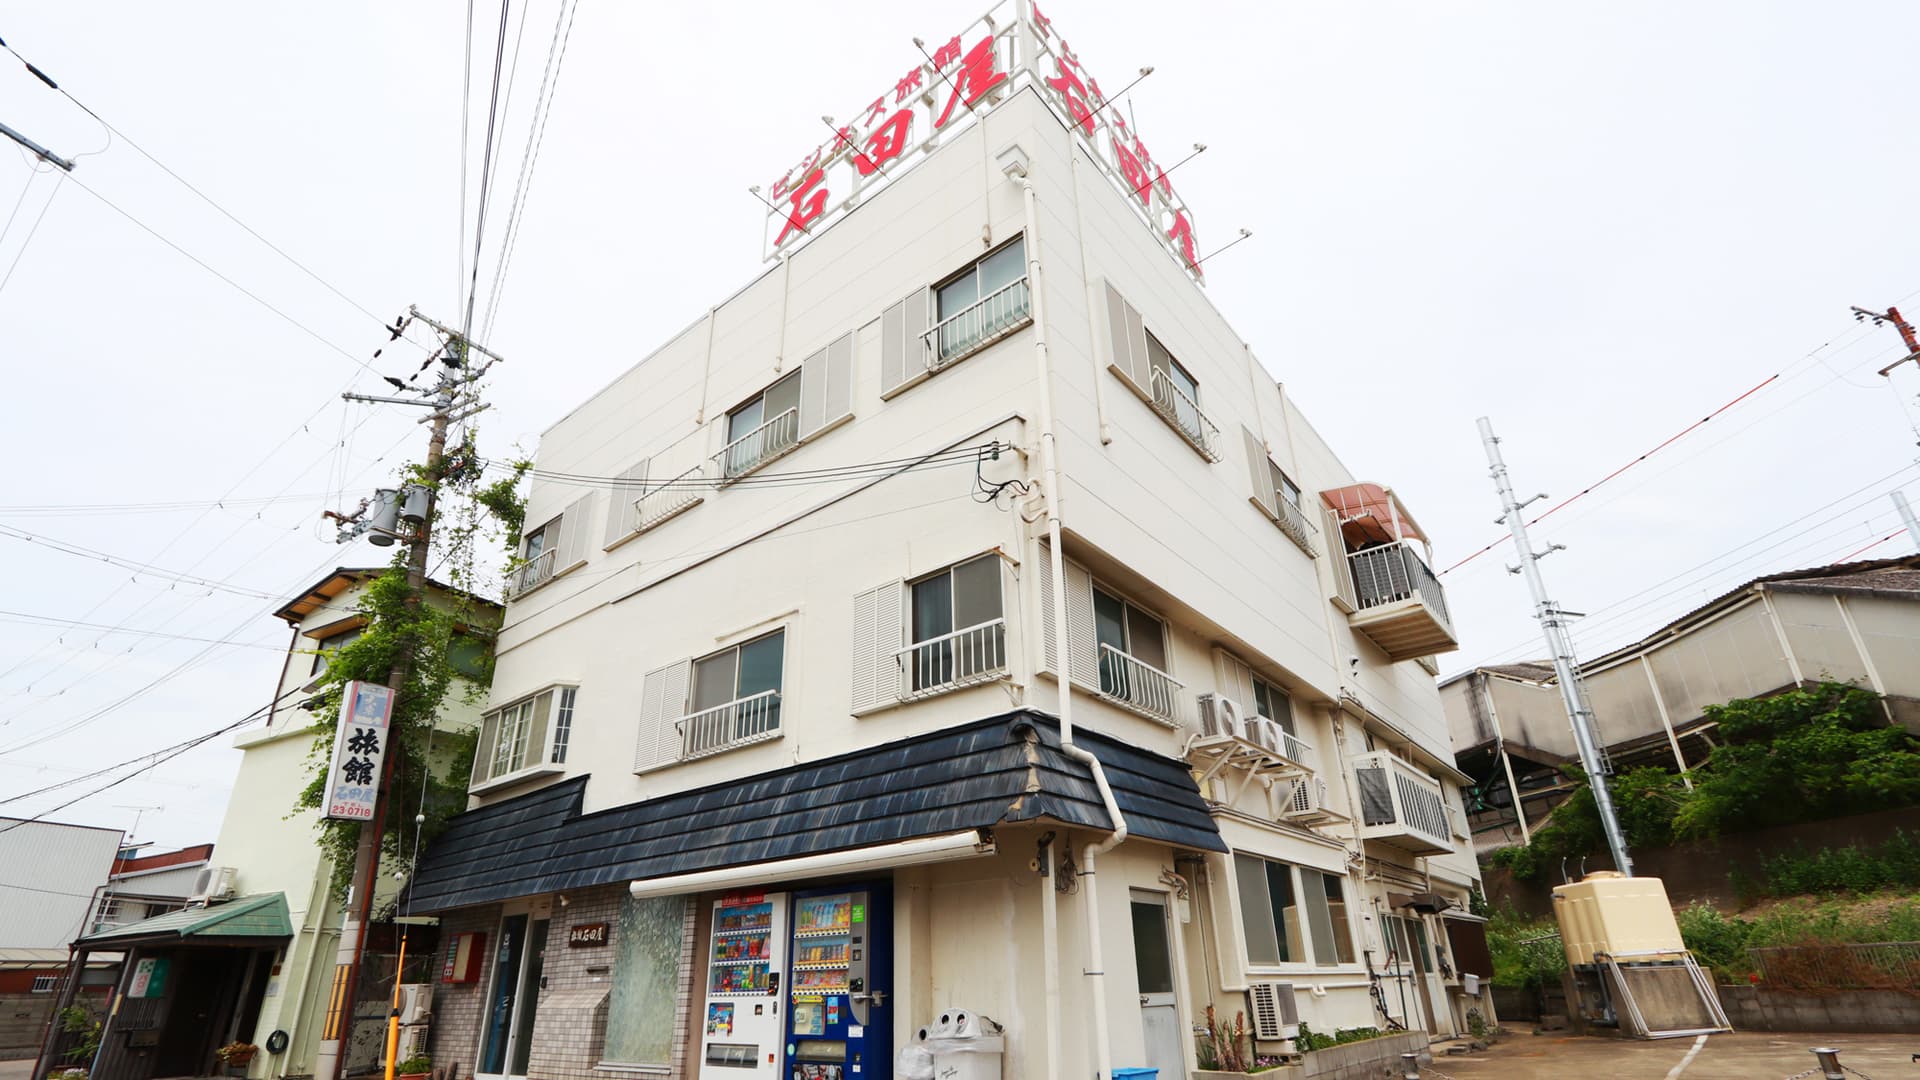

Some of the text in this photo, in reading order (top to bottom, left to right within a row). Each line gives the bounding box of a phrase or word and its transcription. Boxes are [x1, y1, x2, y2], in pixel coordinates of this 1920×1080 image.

[773, 35, 962, 200] ビジネス旅館
[774, 35, 1008, 246] 石田屋
[342, 727, 380, 786] 旅館
